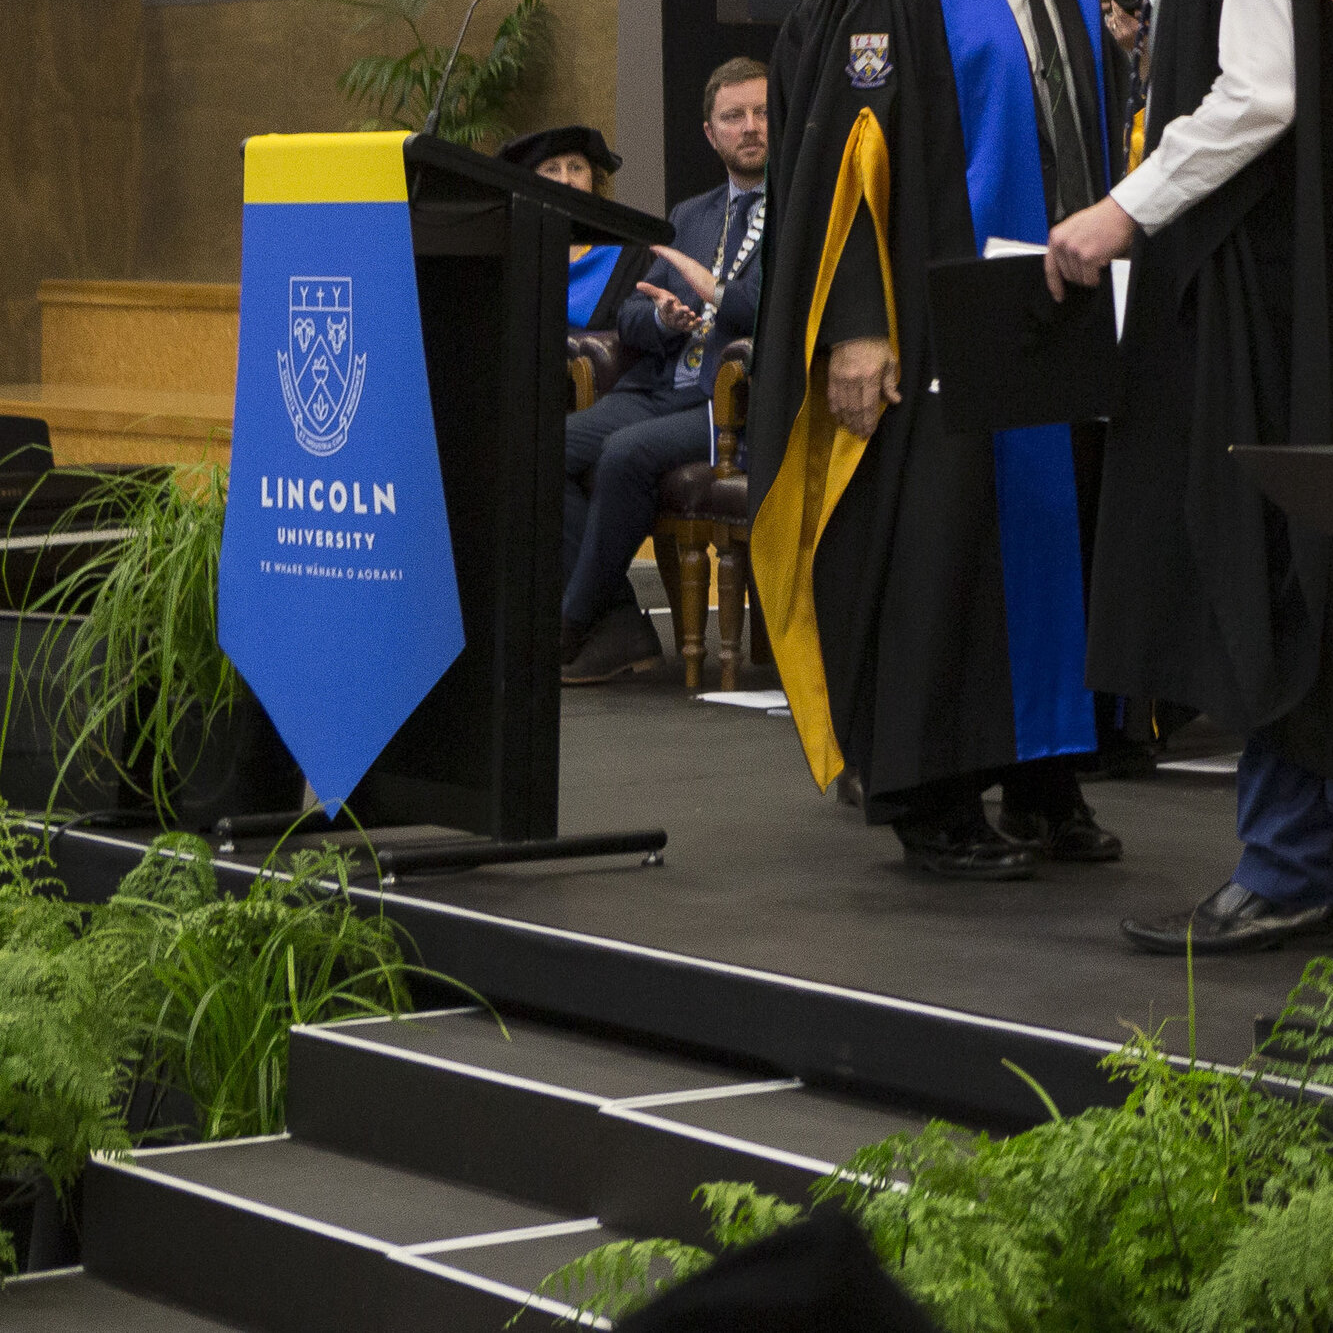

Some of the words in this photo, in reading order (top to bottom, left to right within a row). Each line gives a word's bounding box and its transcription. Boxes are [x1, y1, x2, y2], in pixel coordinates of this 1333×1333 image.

[261, 476, 396, 515] LINCOLN
[278, 527, 376, 551] UNIVERSITY
[357, 568, 403, 581] AORAKI
